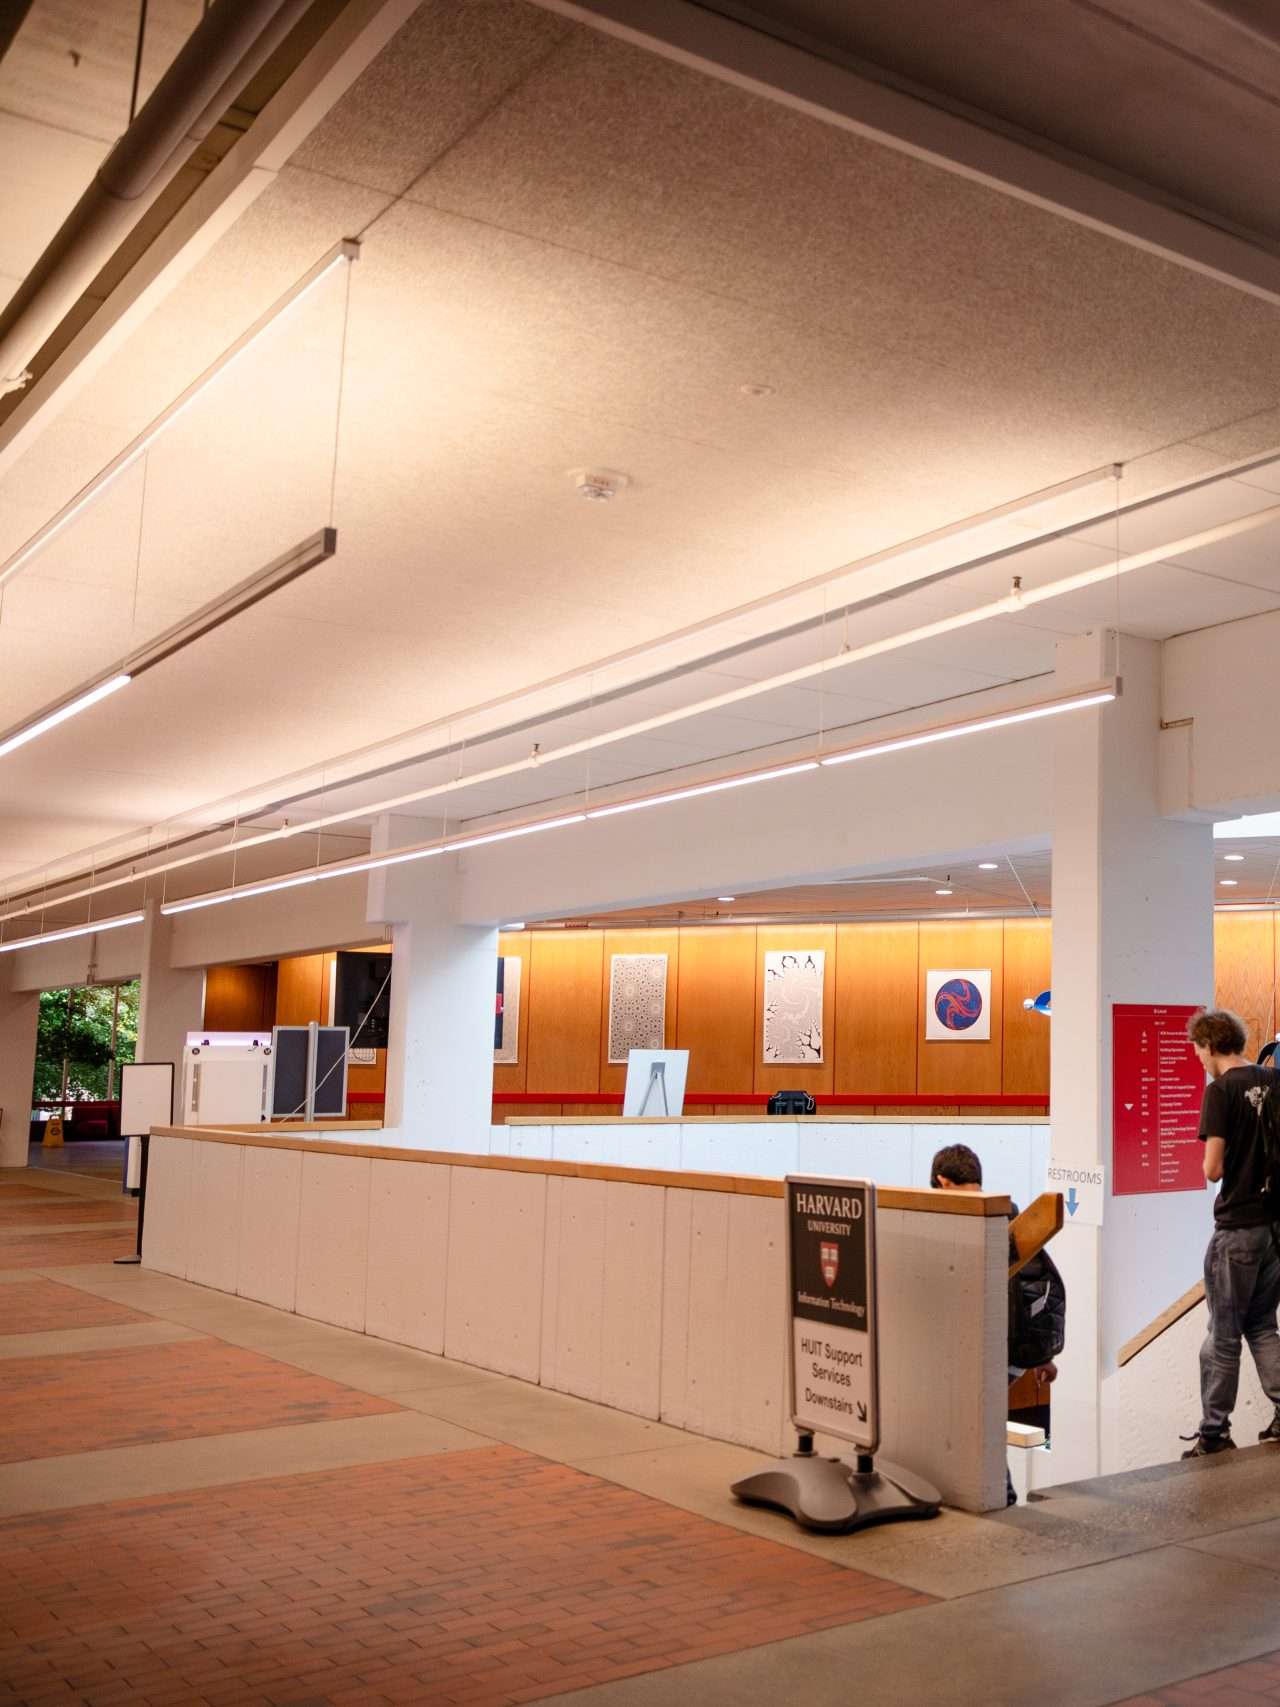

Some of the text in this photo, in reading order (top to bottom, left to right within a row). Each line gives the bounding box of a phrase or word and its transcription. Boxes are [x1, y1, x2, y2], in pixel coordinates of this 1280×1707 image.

[1048, 1167, 1102, 1185] RESTROOMS
[796, 1192, 862, 1219] HARVARD
[807, 1219, 852, 1237] UNIVERSITY
[798, 1290, 865, 1318] Information Technology
[801, 1337, 863, 1368] HUIT Support
[811, 1362, 851, 1387] Services
[804, 1387, 853, 1415] Downstairs
